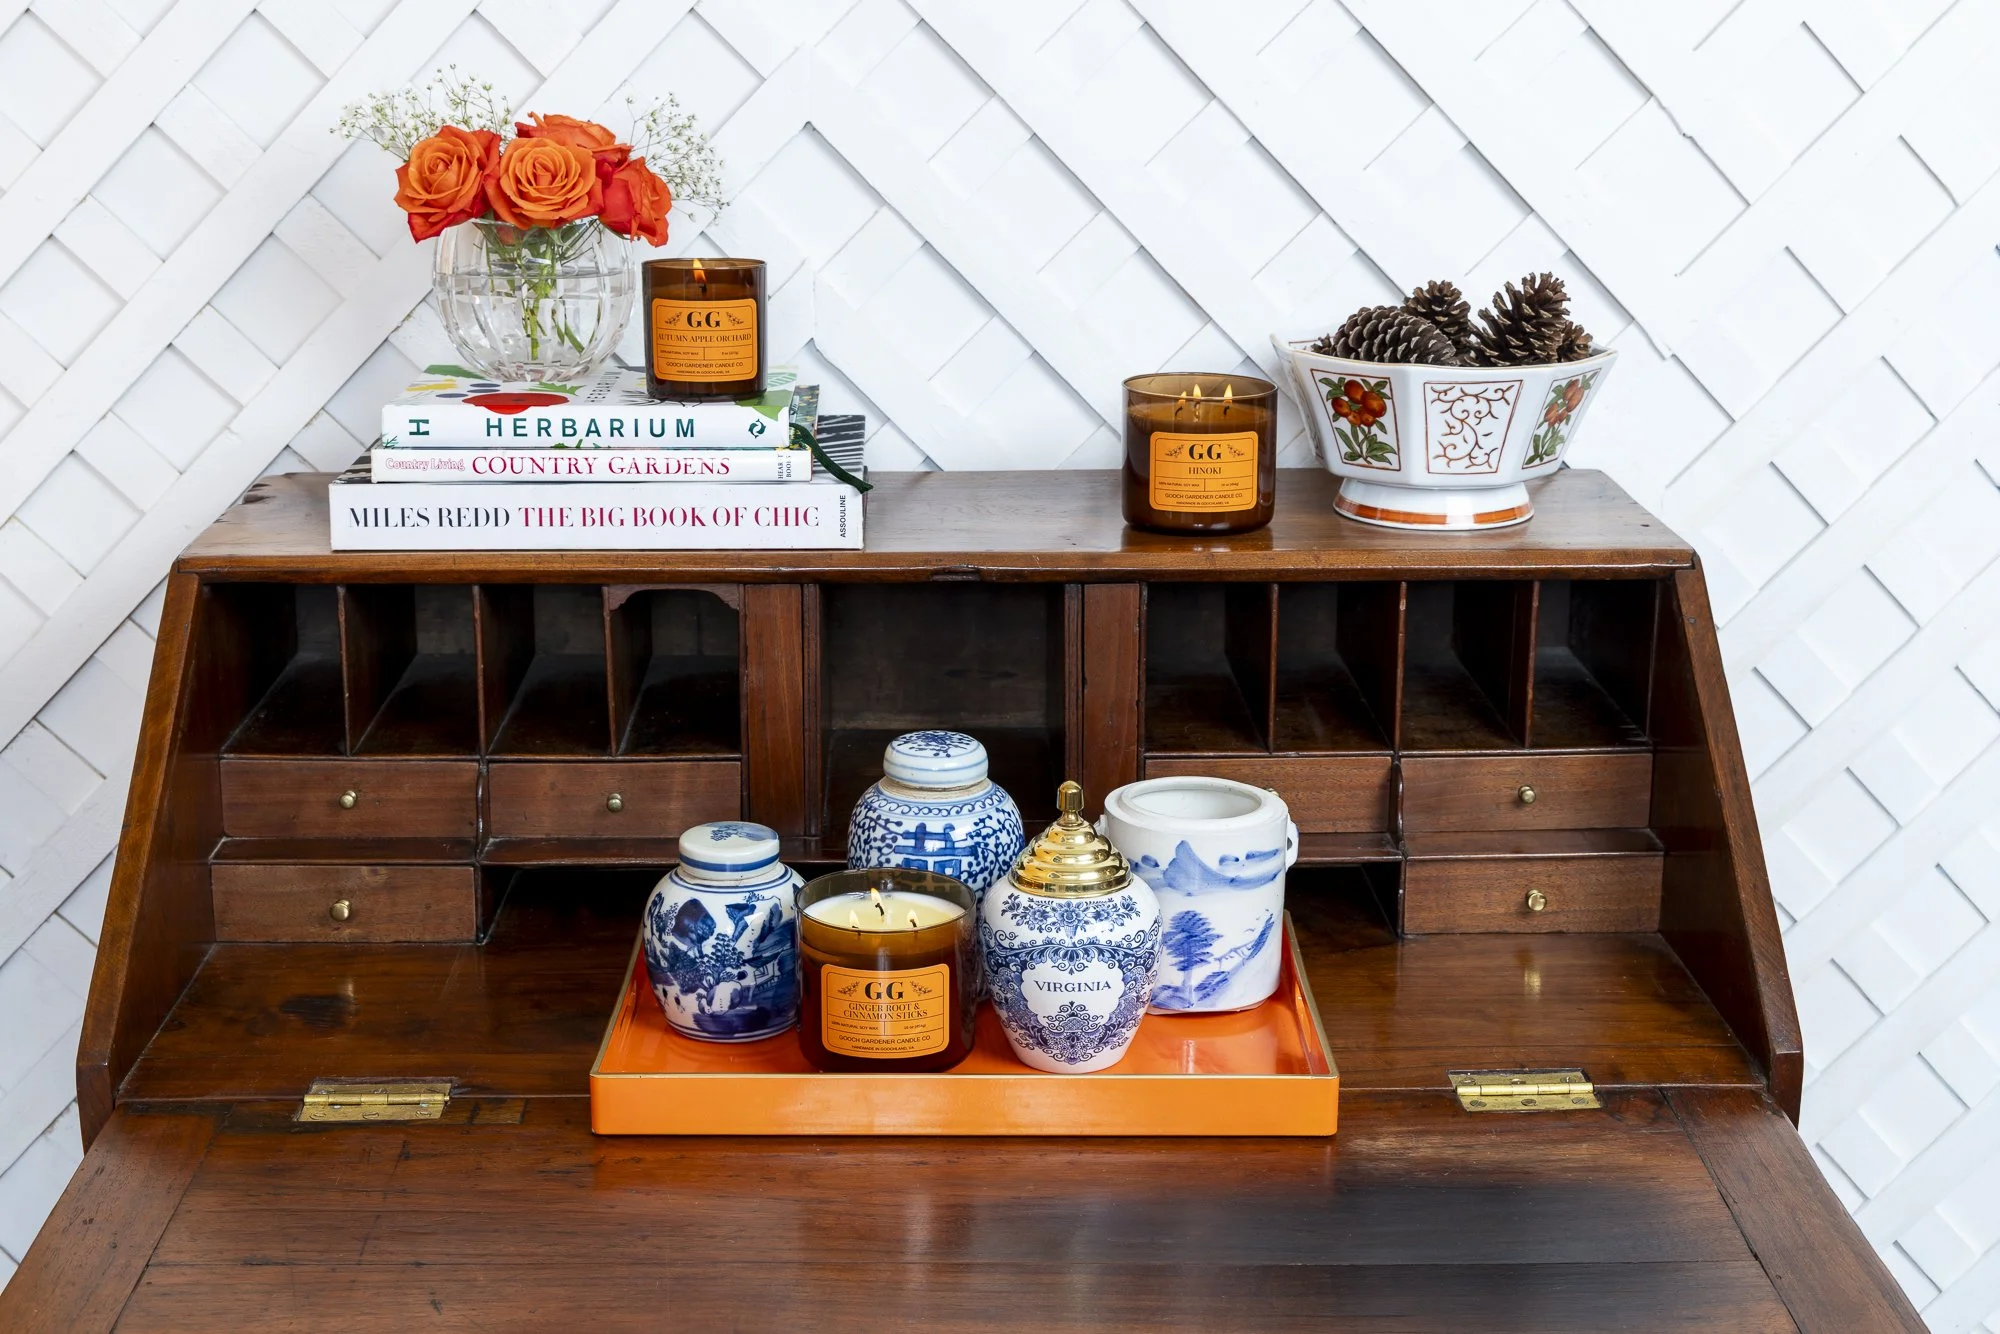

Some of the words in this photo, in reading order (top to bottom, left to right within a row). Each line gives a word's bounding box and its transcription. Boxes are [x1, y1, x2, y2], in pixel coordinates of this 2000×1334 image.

[687, 311, 720, 328] GG
[658, 333, 688, 342] AUTUMN
[716, 333, 751, 341] ORCHARD
[408, 419, 430, 436] H
[486, 418, 695, 438] HERBARIUM
[1188, 443, 1222, 460] GG
[386, 457, 429, 471] Country
[430, 457, 465, 471] Living
[472, 457, 598, 475] COUNTRY
[608, 457, 730, 475] GARDENS
[1188, 466, 1222, 475] HINOKI
[349, 507, 430, 528] MILES
[438, 507, 510, 528] REDD
[518, 507, 574, 528] THE
[582, 507, 625, 528] BIG
[633, 506, 707, 527] BOOK
[713, 506, 748, 527] OF
[754, 506, 820, 527] CHIC
[865, 982, 904, 1000] GG
[1034, 980, 1111, 993] VIRGINIA
[848, 1002, 883, 1012] GINGER
[886, 1003, 911, 1012] ROOT
[913, 1002, 920, 1010] &
[843, 1010, 894, 1020] CINNAMON
[896, 1010, 928, 1019] STICKS
[897, 1036, 920, 1044] CANDLE
